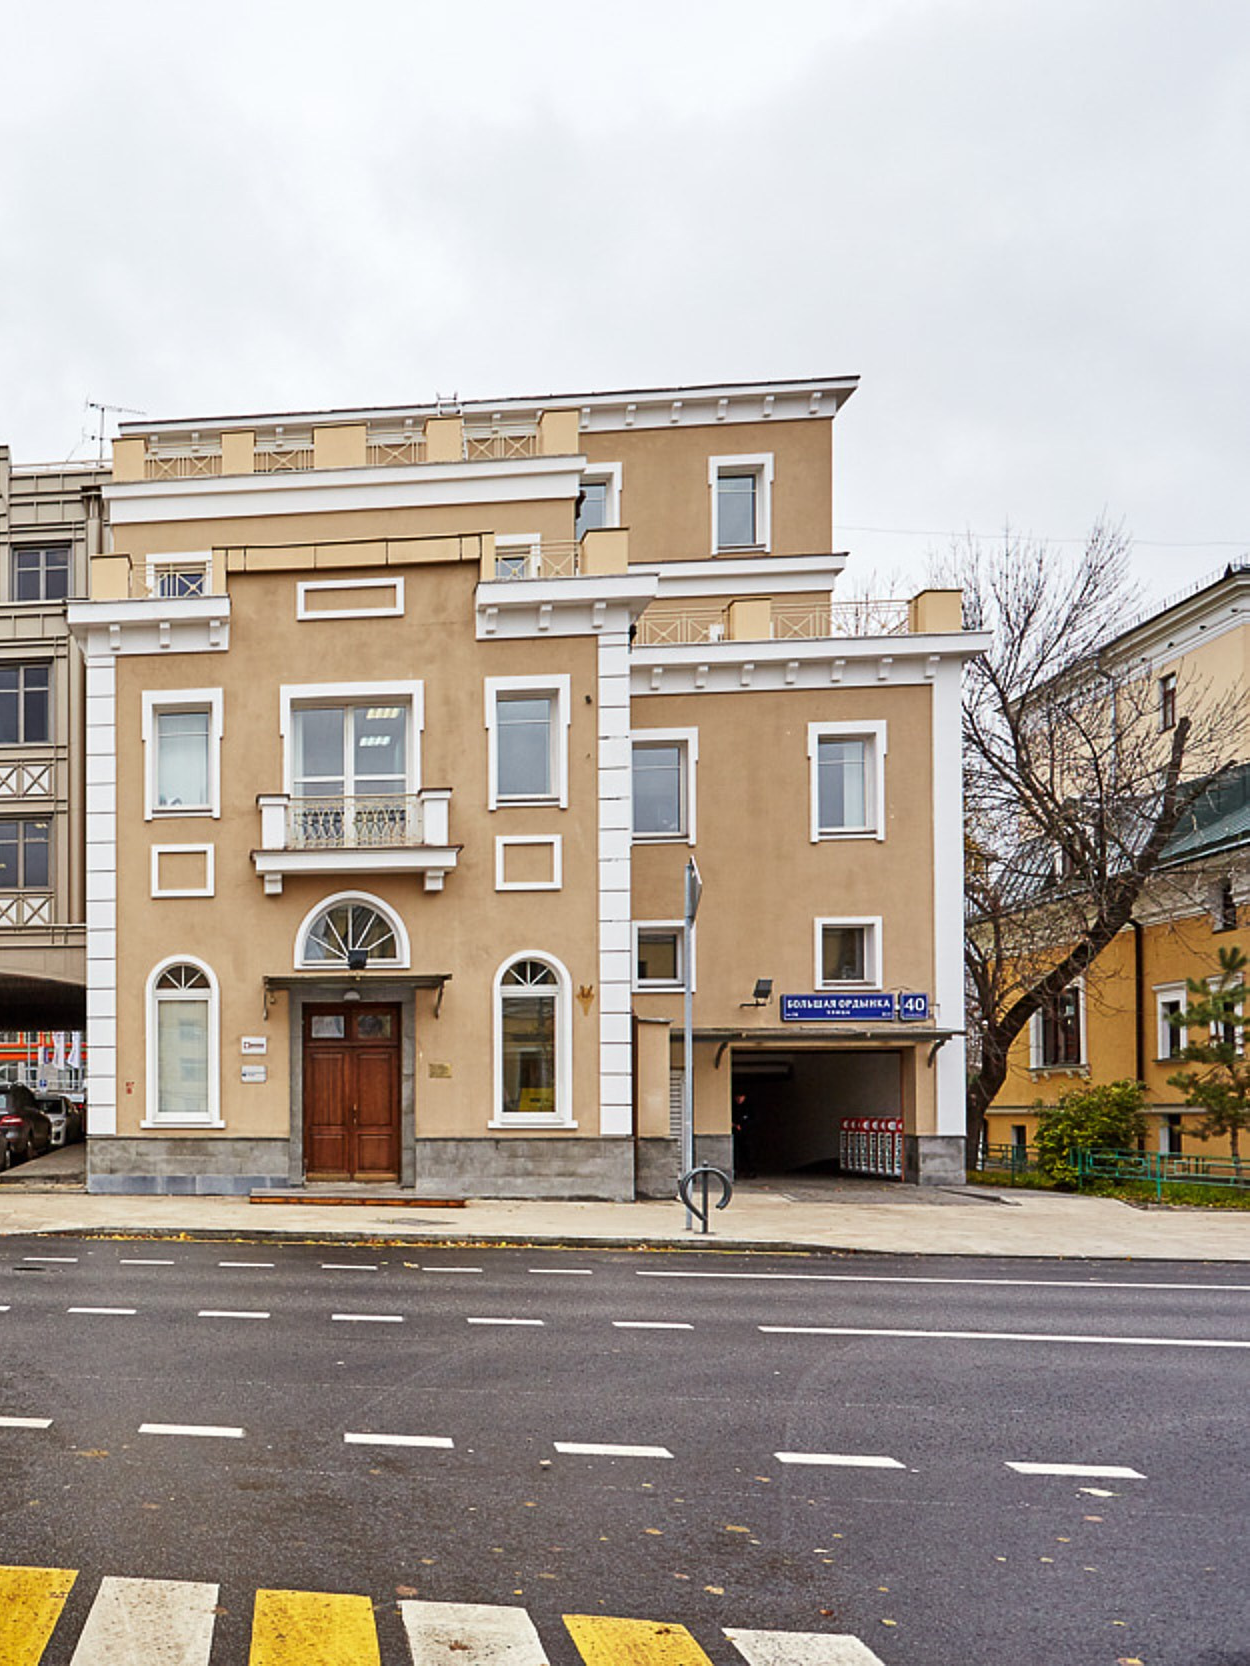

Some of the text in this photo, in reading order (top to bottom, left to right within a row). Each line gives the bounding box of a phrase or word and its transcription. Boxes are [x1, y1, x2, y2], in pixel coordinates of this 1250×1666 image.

[787, 999, 891, 1009] БОЛЬШАЯ ОРДЫНКА
[905, 997, 925, 1012] 40
